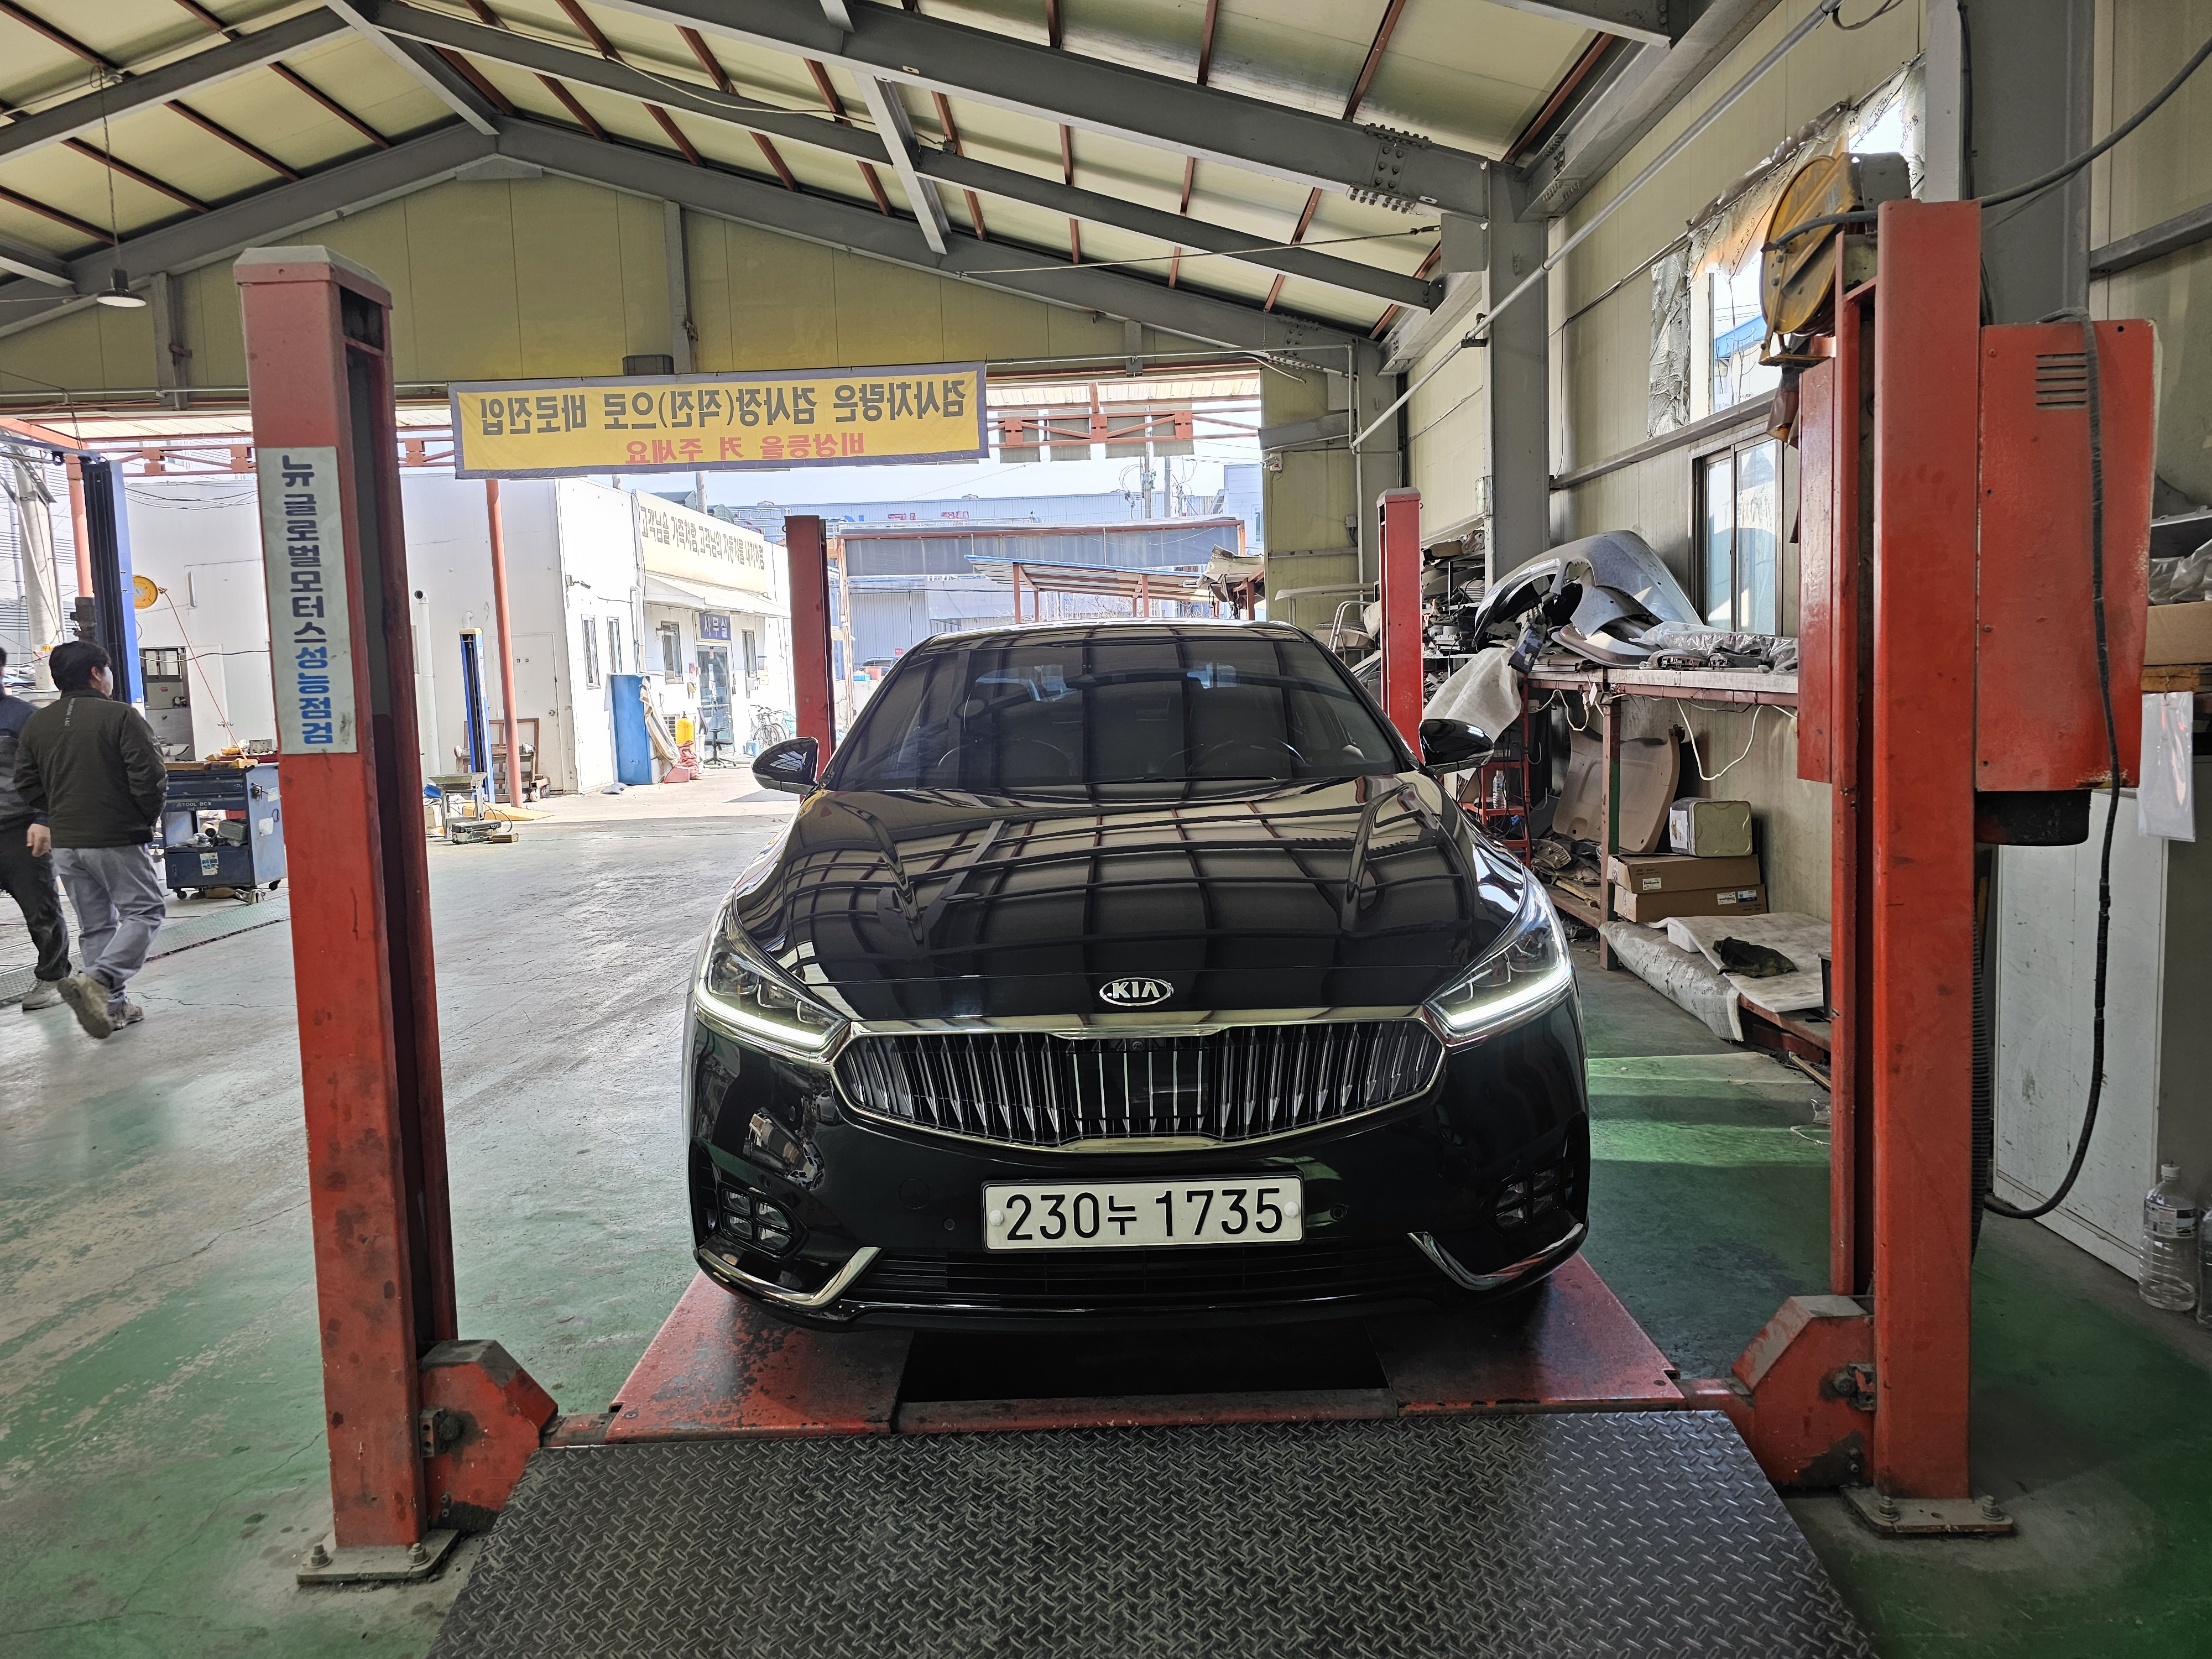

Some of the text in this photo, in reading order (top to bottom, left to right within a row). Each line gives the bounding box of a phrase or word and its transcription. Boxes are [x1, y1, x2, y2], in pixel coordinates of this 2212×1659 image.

[640, 505, 670, 545] 고객님을
[723, 533, 745, 565] 자동차를
[703, 615, 728, 639] 사무실
[1112, 981, 1160, 999] KIA
[1005, 1188, 1282, 1240] 230누 1735
